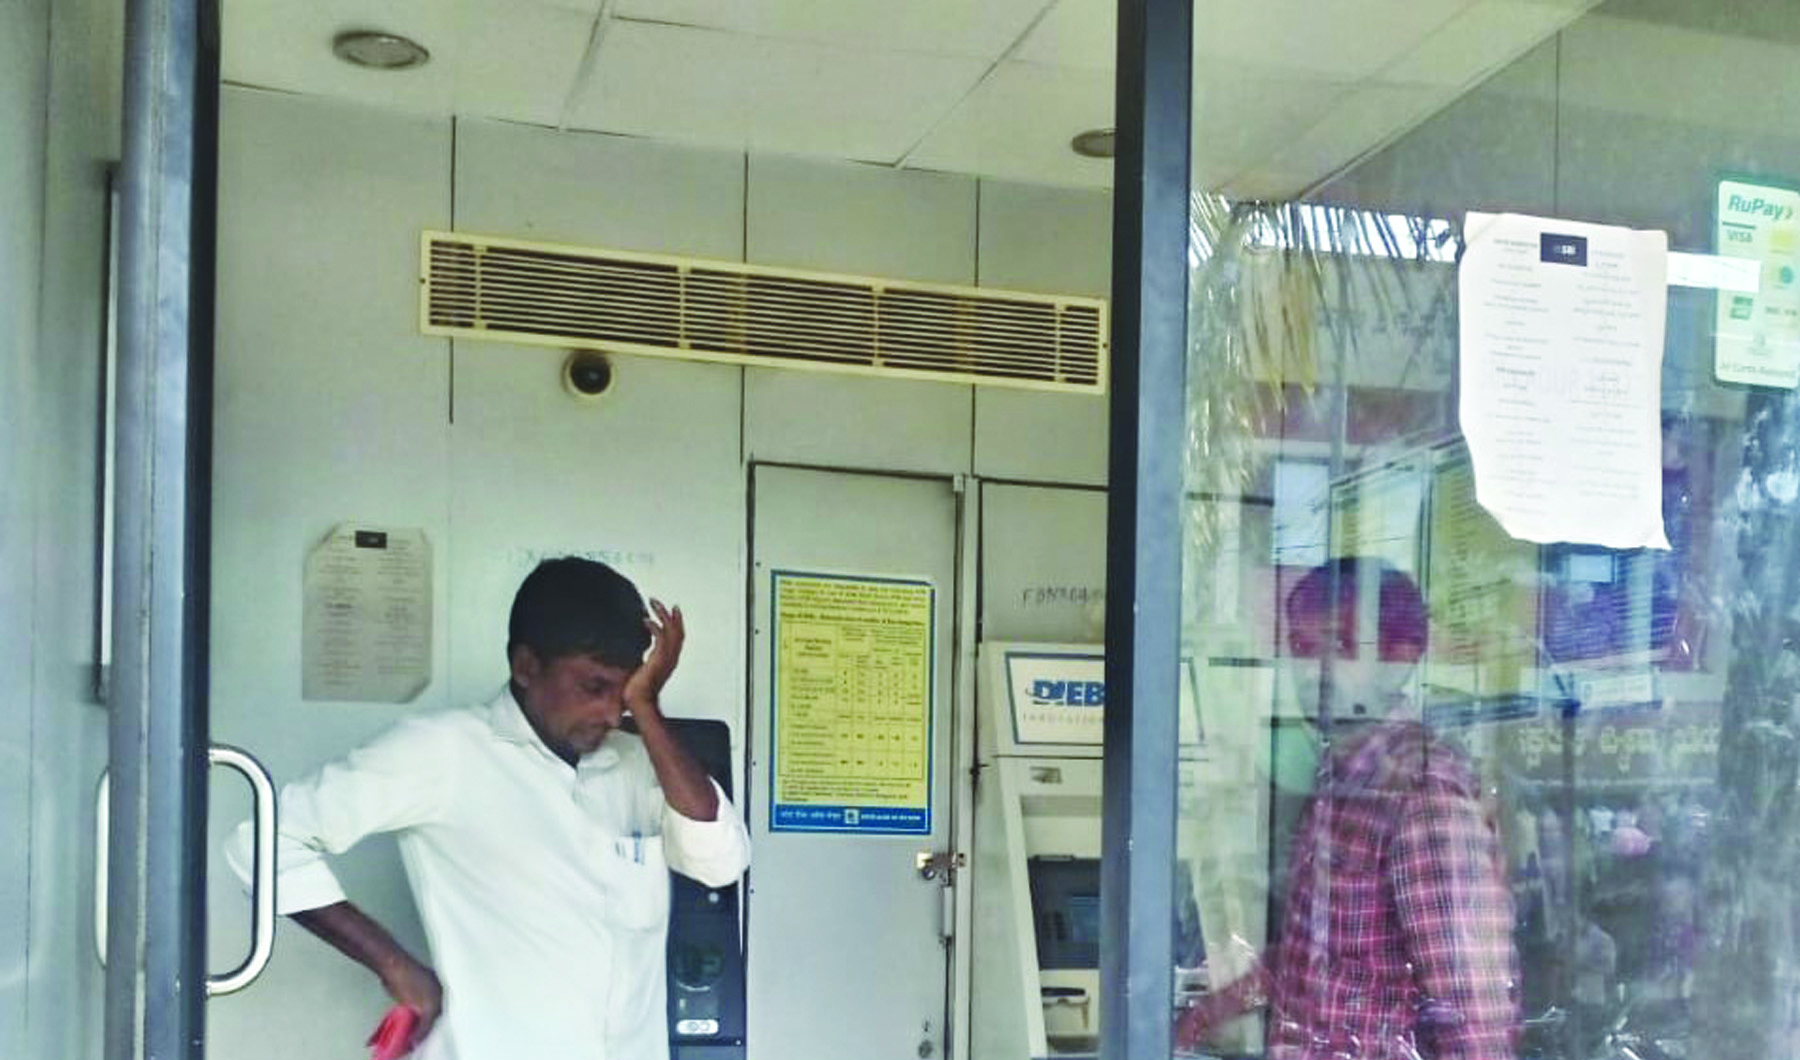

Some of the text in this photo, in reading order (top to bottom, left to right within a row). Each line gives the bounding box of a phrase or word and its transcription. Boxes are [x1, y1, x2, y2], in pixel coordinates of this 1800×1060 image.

[1728, 194, 1784, 221] RuPay
[1727, 230, 1753, 243] VISA
[1032, 680, 1106, 706] DIEB
